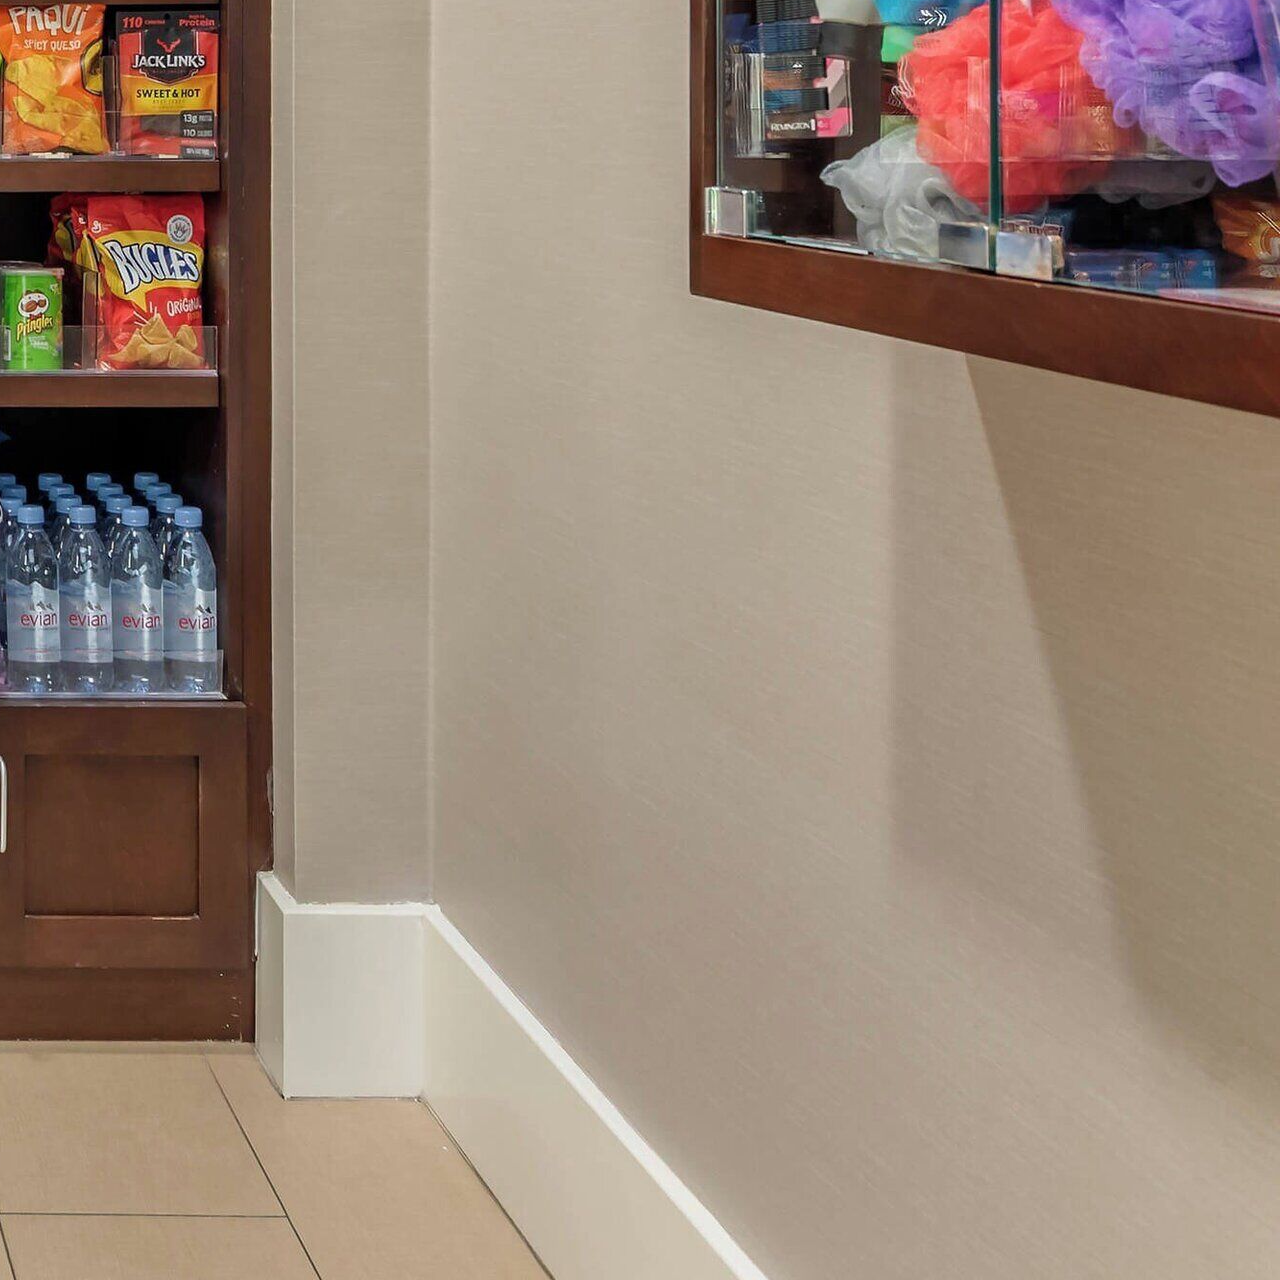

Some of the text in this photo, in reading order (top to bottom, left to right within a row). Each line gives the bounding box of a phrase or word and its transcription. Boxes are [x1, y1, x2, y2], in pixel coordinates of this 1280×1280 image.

[7, 4, 92, 37] PAQUI
[122, 17, 143, 29] 110
[178, 18, 216, 27] Protein
[23, 38, 82, 51] SPICY QUESO
[131, 53, 206, 69] JACK LINK'S
[136, 88, 201, 98] SWEET & HOT
[770, 120, 812, 134] REMINGTON
[102, 240, 200, 295] BUGLES
[16, 313, 54, 341] Pringles
[20, 612, 58, 627] evian
[68, 612, 108, 628] evian
[121, 614, 161, 630] evian
[178, 615, 217, 631] evian
